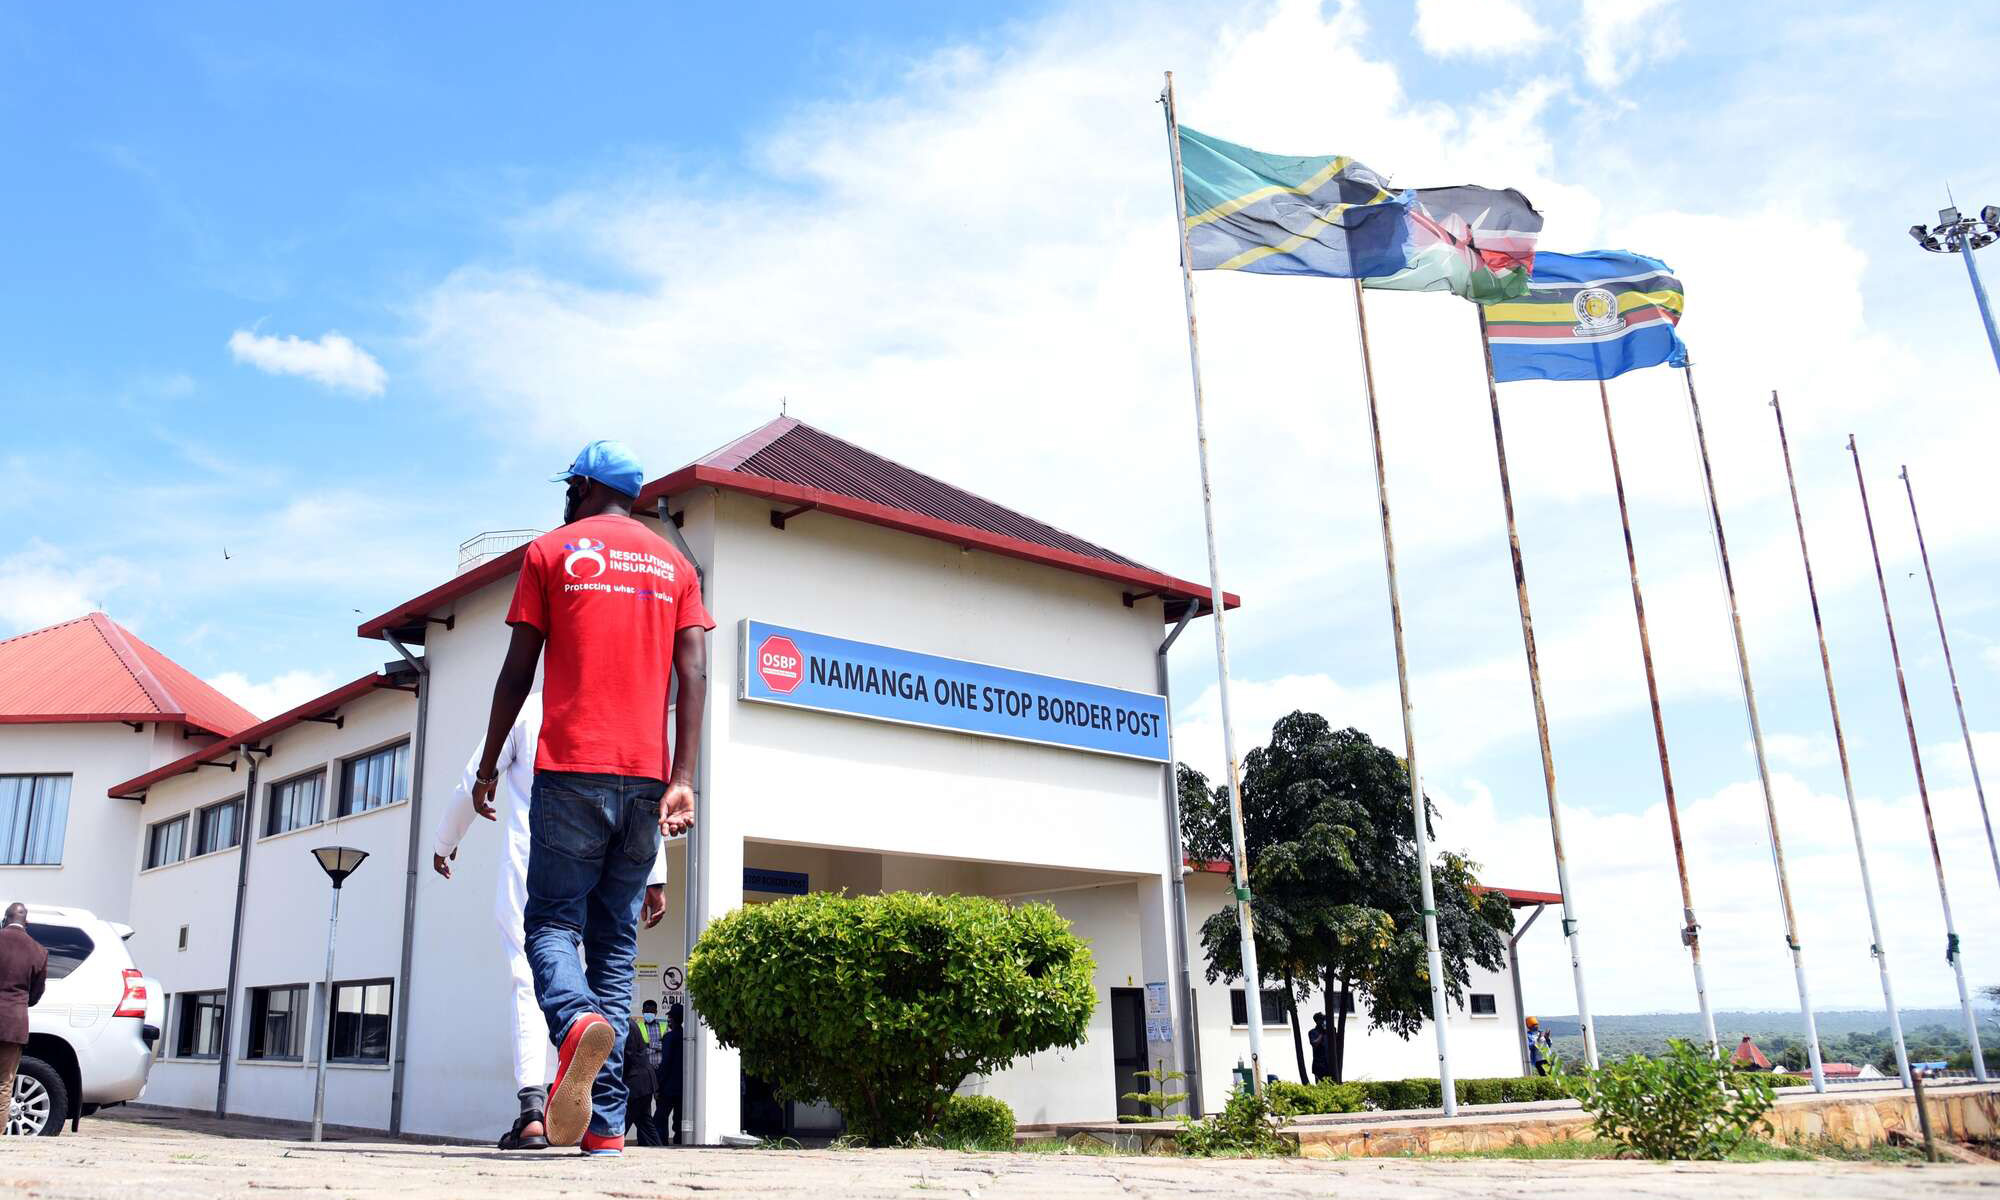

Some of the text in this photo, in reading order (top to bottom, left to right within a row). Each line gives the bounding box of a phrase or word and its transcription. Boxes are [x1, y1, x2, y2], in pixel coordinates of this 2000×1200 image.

[609, 549, 675, 573] RESOLUTION
[609, 561, 675, 582] INSURANCE
[613, 584, 636, 594] what
[763, 653, 797, 669] OSBP
[810, 656, 1160, 738] NAMANGA ONE STOP BORDER POST
